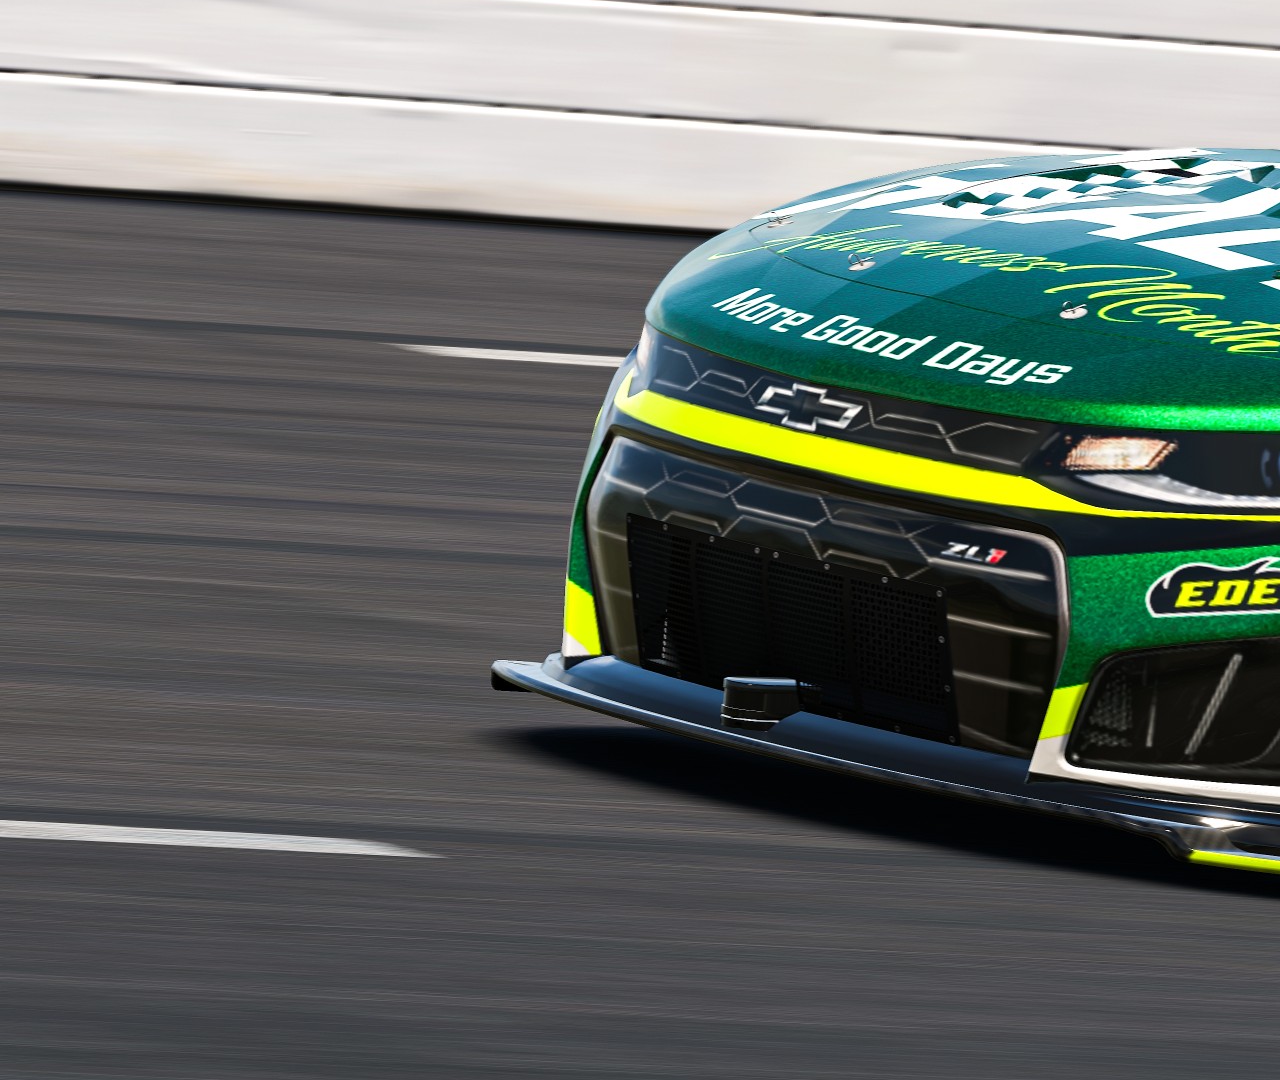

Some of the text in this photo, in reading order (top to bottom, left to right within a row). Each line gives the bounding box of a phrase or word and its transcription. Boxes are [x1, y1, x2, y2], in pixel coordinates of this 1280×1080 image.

[707, 224, 1068, 272] Awareness
[711, 288, 1074, 386] More Good Days
[941, 541, 1008, 564] ZL1
